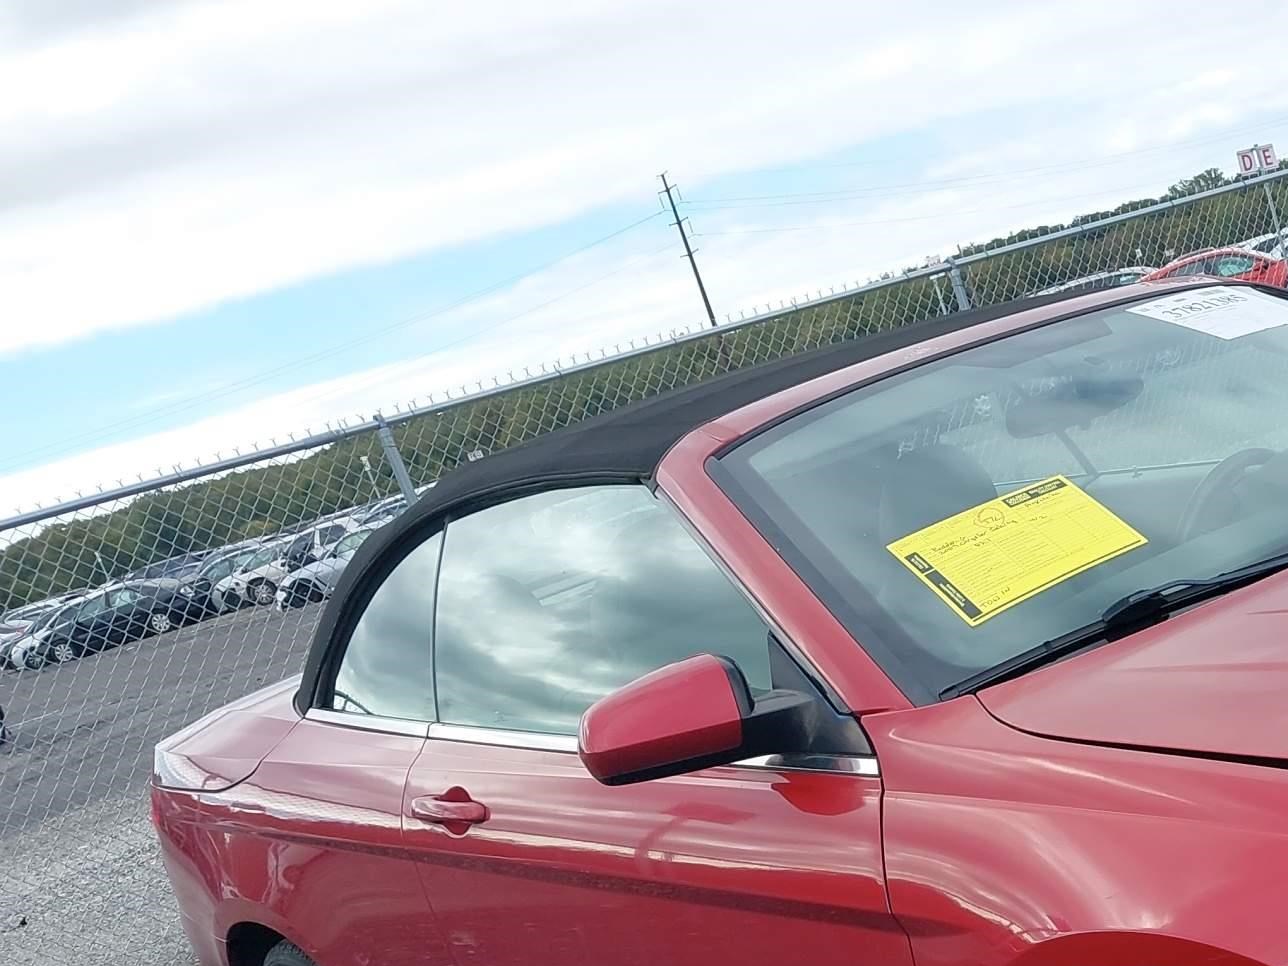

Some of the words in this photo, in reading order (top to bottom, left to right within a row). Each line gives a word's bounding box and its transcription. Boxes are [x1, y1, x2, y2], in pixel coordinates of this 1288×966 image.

[1241, 154, 1253, 171] D
[1262, 148, 1273, 166] E
[1162, 294, 1249, 318] 37821385
